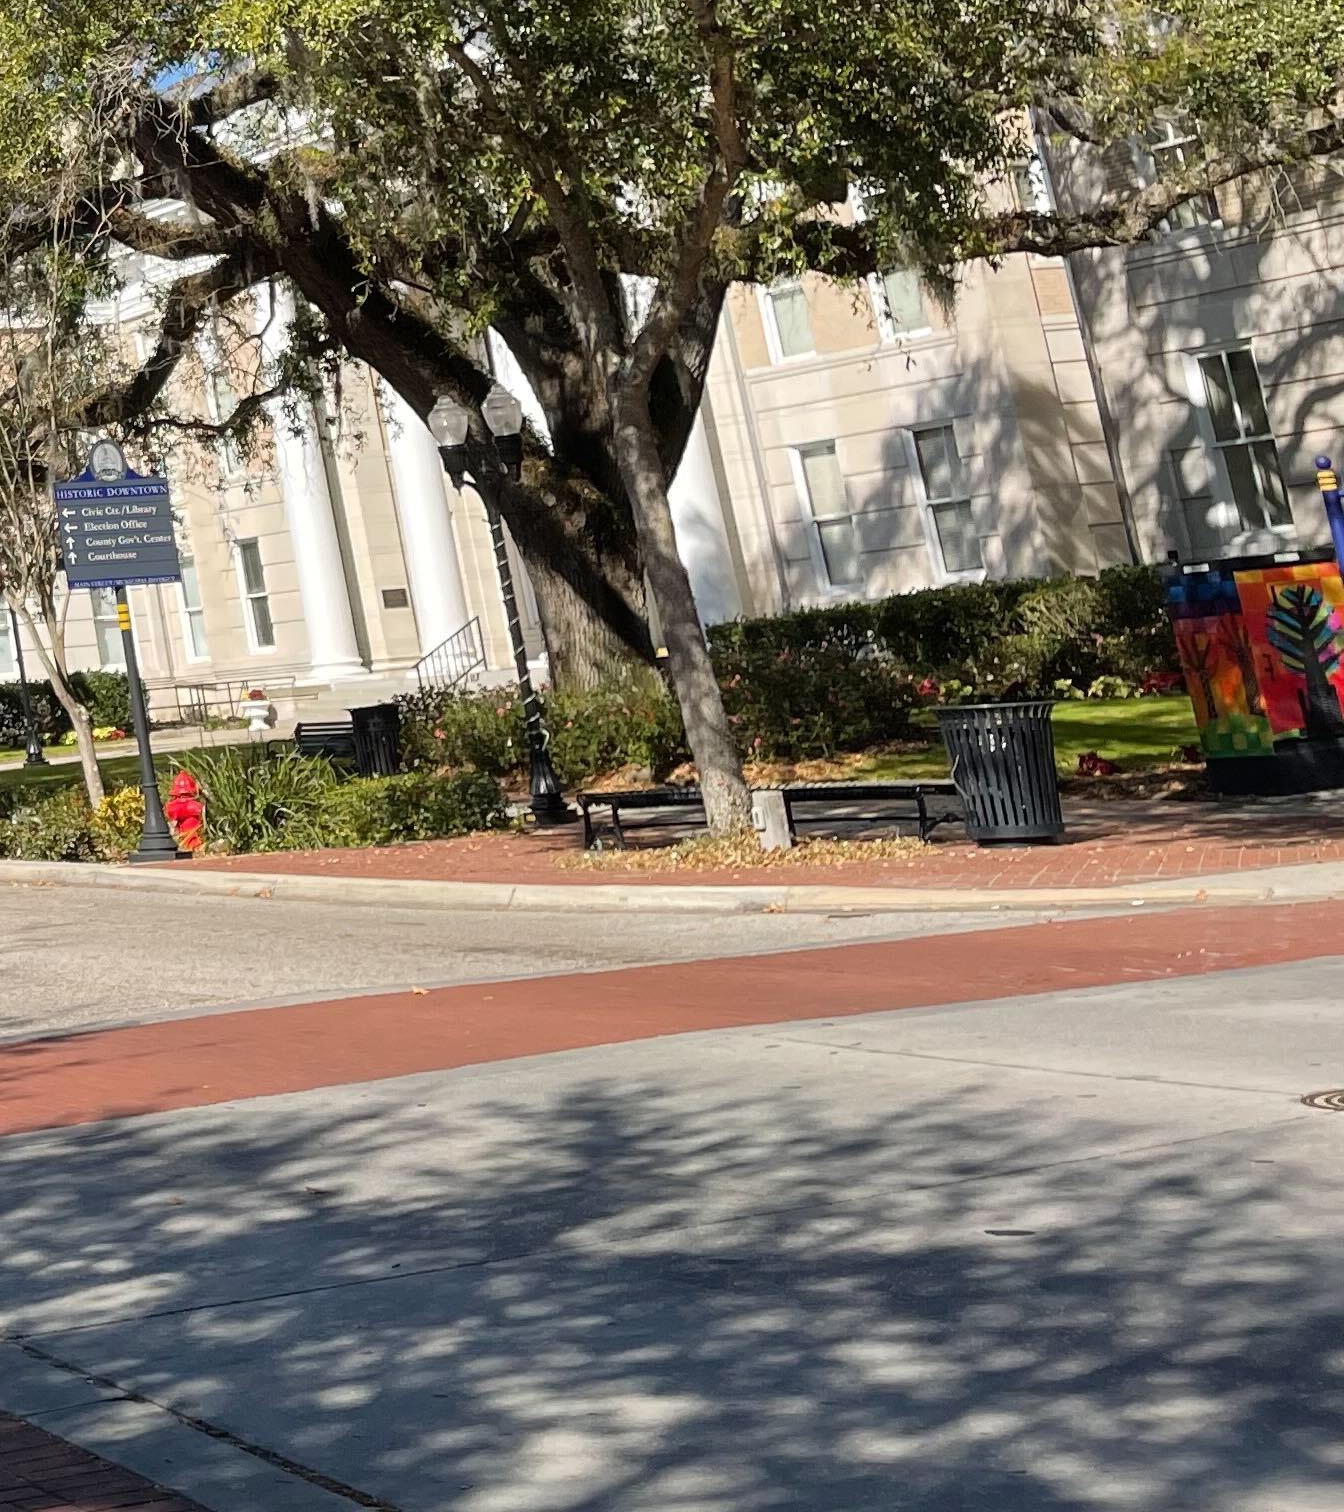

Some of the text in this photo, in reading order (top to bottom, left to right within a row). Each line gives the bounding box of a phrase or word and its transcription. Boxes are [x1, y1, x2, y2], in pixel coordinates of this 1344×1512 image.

[56, 485, 167, 499] HISTORIC DOWNTOWN
[82, 508, 103, 517] Civic
[84, 520, 147, 531] Election Office
[86, 538, 116, 547] County
[144, 535, 171, 543] Center
[88, 552, 137, 561] Courthouse
